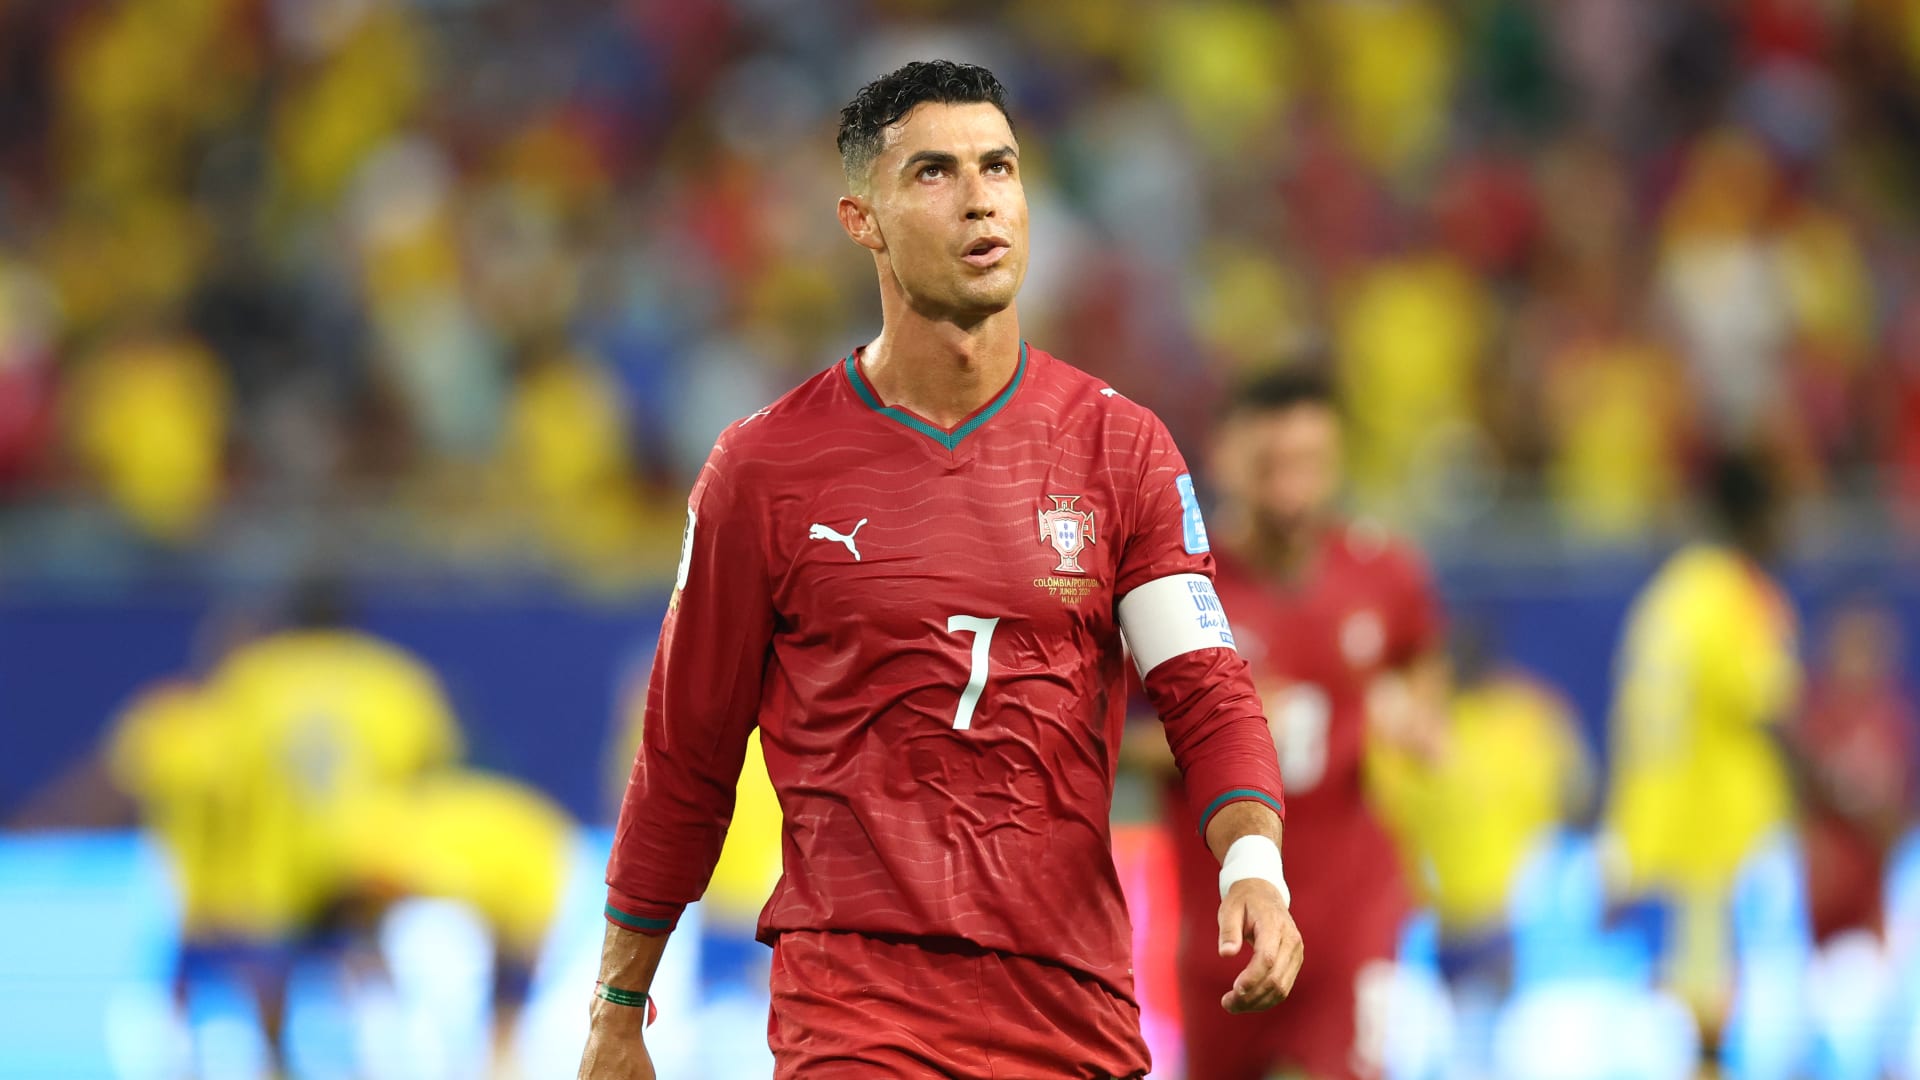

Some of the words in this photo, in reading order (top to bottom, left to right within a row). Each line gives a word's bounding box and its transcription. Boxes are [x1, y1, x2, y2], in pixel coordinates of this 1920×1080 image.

[1033, 577, 1099, 587] COLÔMBIA/PORTUGA
[1060, 587, 1078, 595] JUNHO
[1061, 595, 1082, 604] MIAMI
[1196, 613, 1219, 629] the
[947, 615, 1000, 731] 7
